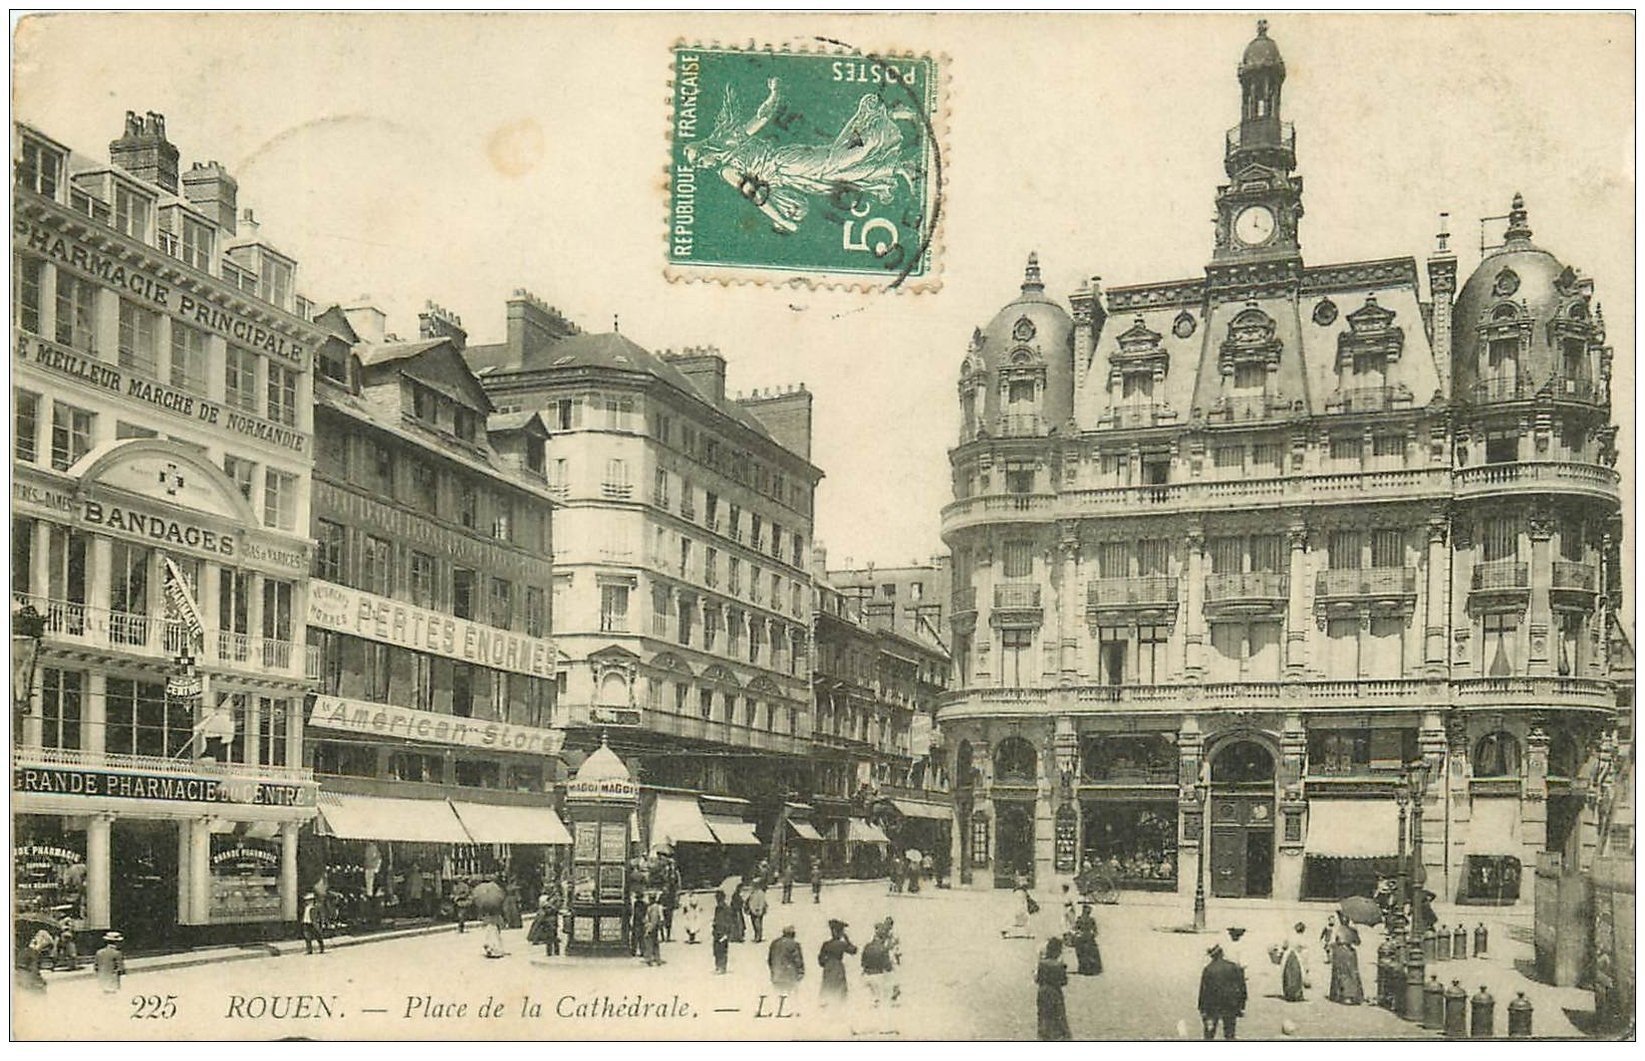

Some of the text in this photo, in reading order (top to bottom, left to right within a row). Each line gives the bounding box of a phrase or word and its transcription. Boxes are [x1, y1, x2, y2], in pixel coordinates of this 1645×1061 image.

[678, 54, 700, 138] FRANÇAISE
[832, 61, 916, 86] POSTES
[180, 295, 304, 362] PRINCIPALE
[35, 344, 121, 391] MEILLEUR
[200, 403, 219, 424] DE
[226, 412, 304, 450] NORMANDIE
[84, 500, 235, 556] BANDAGES
[107, 775, 216, 801] PHARMACIE
